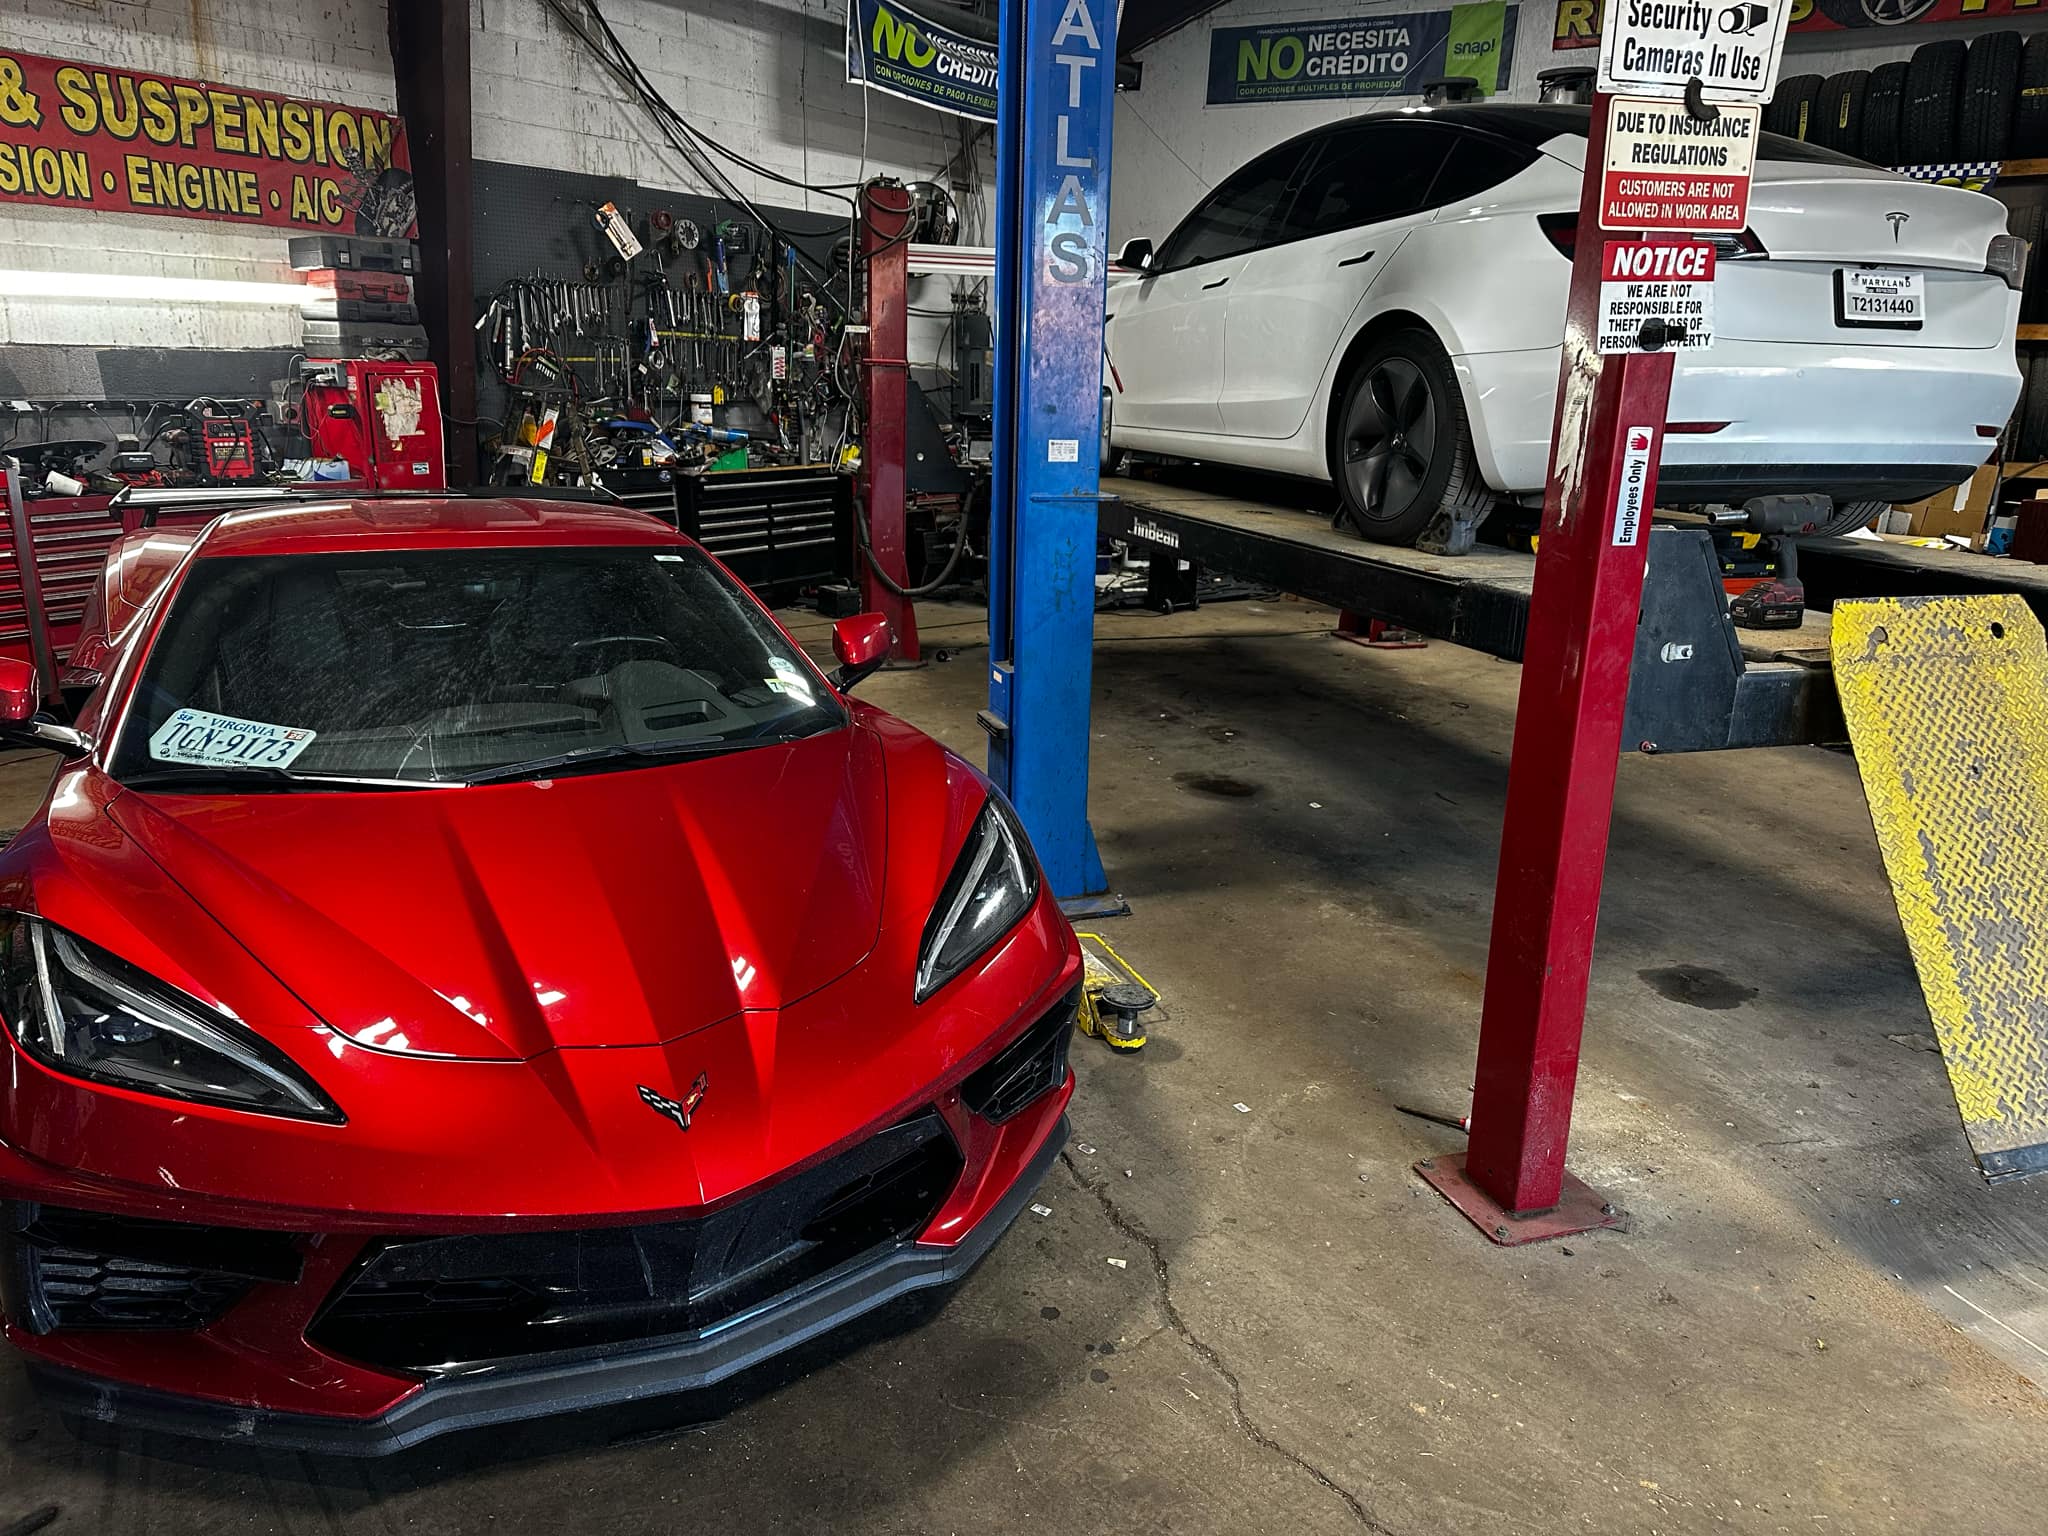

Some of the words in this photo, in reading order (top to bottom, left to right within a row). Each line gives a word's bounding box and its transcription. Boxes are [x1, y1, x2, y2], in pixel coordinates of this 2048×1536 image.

[1627, 0, 1712, 39] Security
[873, 4, 937, 69] NO
[1453, 37, 1496, 57] snap!
[1237, 36, 1305, 81] NO
[1308, 28, 1411, 52] NECESITA
[1306, 51, 1408, 77] CRÉDITO
[1623, 37, 1704, 76] Cameras
[1708, 43, 1727, 78] In
[1731, 46, 1761, 81] Use
[875, 64, 891, 78] CON
[933, 84, 945, 95] DE
[946, 87, 965, 101] PAGO
[1341, 82, 1353, 90] DE
[0, 57, 43, 129] &
[56, 67, 392, 170] SUSPENSION
[1616, 111, 1645, 133] DUE
[1648, 113, 1666, 134] TO
[1668, 114, 1751, 138] INSURANCE
[1046, 0, 1101, 284] ATLAS
[1631, 143, 1728, 167] REGULATIONS
[125, 155, 262, 216] ENGINE
[291, 175, 344, 224] A/C
[1618, 178, 1686, 197] CUSTOMERS
[1687, 181, 1711, 198] ARE
[1711, 183, 1735, 199] NOT
[1608, 201, 1659, 218] ALLOWED
[1660, 203, 1672, 219] IN
[1675, 204, 1708, 220] WORK
[1709, 205, 1739, 221] AREA
[1611, 246, 1710, 277] NOTICE
[1627, 284, 1644, 298] WE
[1644, 284, 1668, 298] ARE
[1670, 284, 1692, 298] NOT
[1861, 278, 1911, 288] MARYLAND
[1610, 301, 1683, 315] RESPONSIBLE
[1684, 300, 1702, 314] FOR
[1852, 296, 1914, 314] T2131440
[1608, 318, 1642, 332] THEFT
[1689, 317, 1703, 331] OF
[1628, 459, 1646, 484] Only
[1619, 485, 1639, 544] Employees
[210, 718, 277, 738] VIRGINIA
[160, 722, 296, 762] TGN-9173
